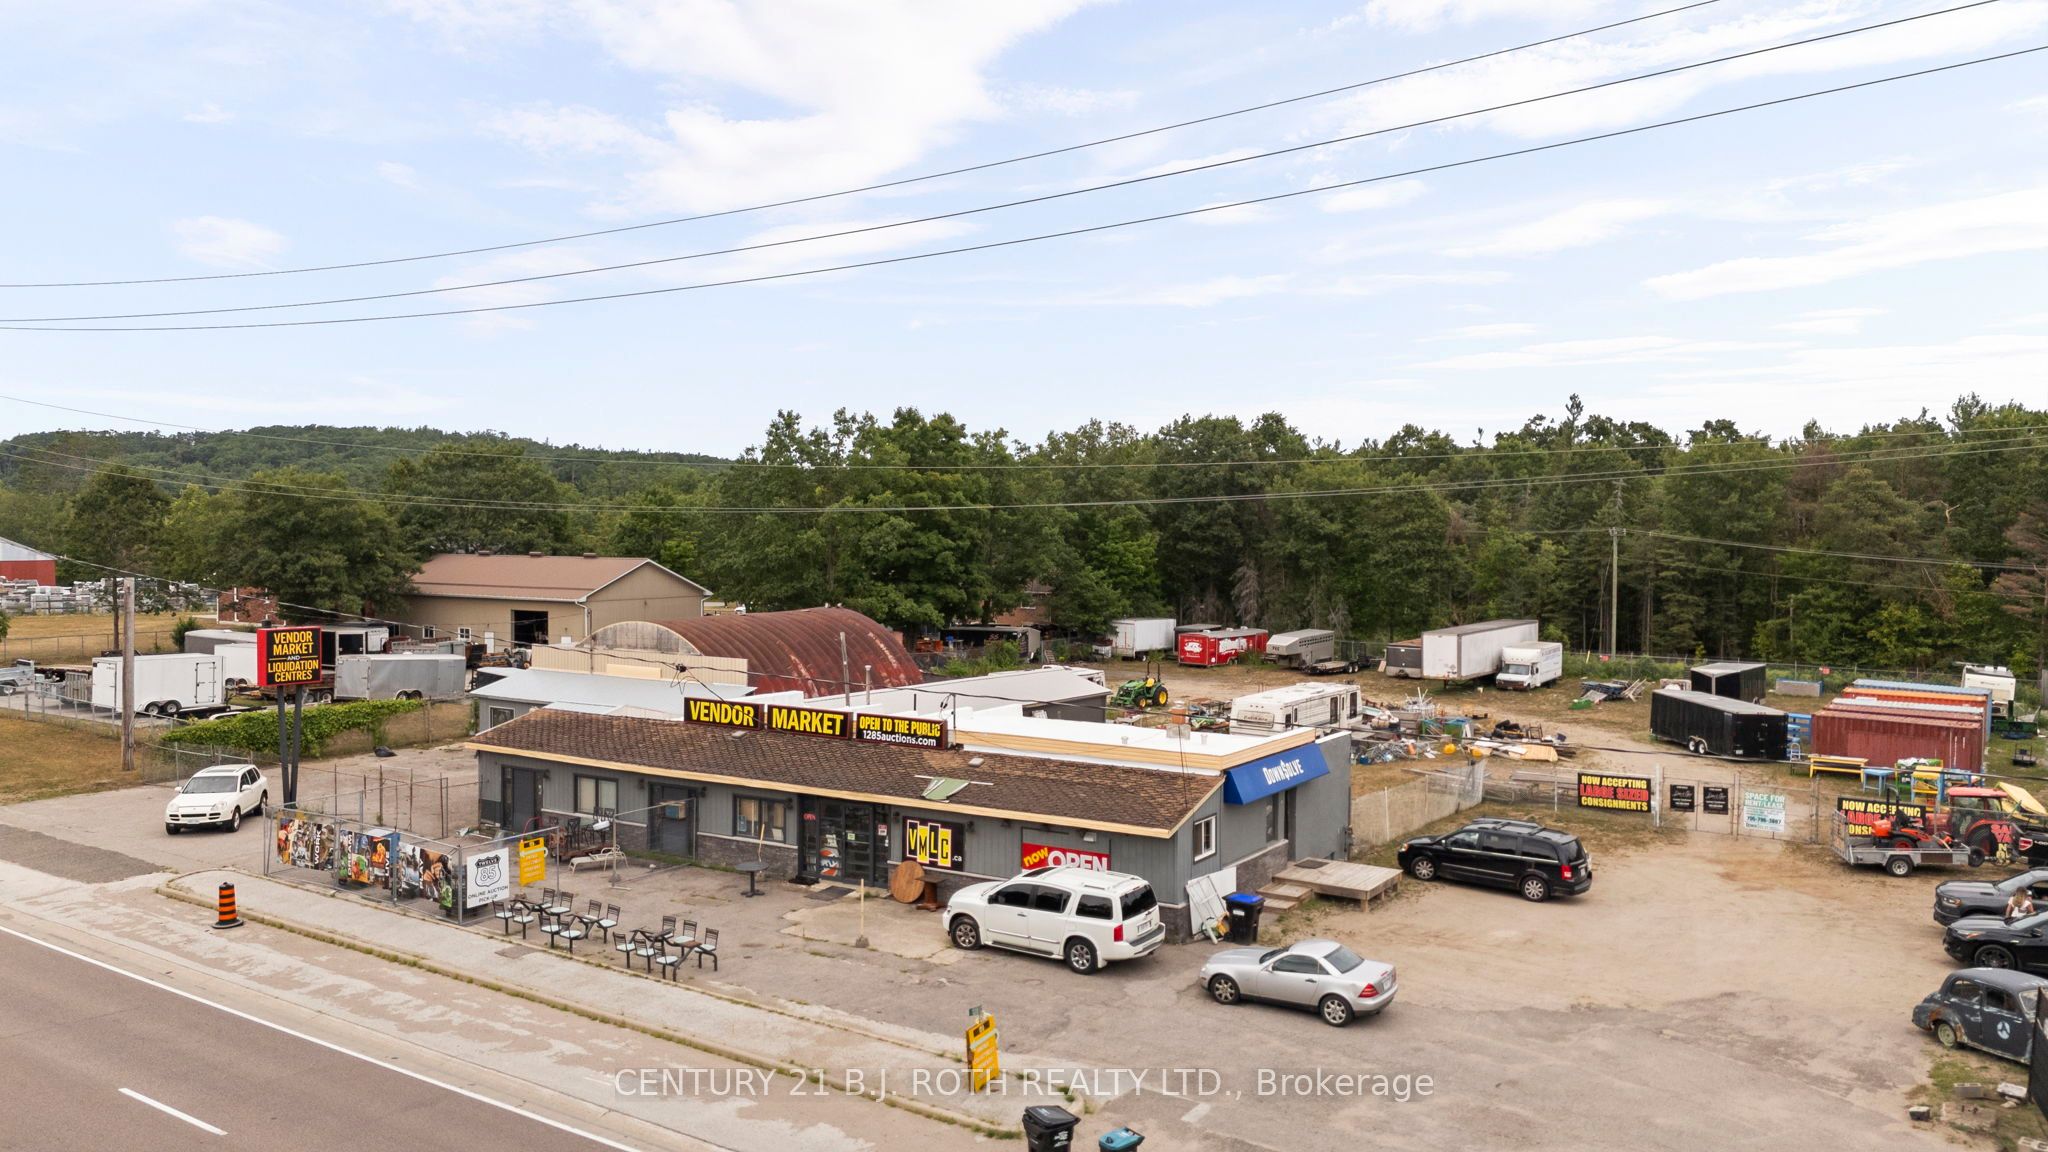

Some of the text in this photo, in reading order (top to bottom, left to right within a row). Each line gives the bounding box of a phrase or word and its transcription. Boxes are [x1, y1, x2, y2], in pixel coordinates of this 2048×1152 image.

[273, 631, 313, 644] VENDOR
[273, 642, 314, 656] MARKET
[268, 659, 319, 673] LIQUIDATION
[274, 670, 313, 683] CENTRES
[690, 700, 844, 736] VENDOR MARKET
[859, 716, 941, 737] OPEN TO THE PUBLIC
[862, 730, 937, 746] 1285auctions.com
[1581, 775, 1647, 790] NOW ACCEPTING
[1580, 784, 1649, 801] LARGE SIZED
[1744, 791, 1769, 801] SPACE
[1581, 796, 1648, 811] CONSIGNMENTS
[1842, 800, 1866, 812] NOW
[314, 830, 322, 865] WORK
[478, 857, 498, 867] TWELVE
[1023, 847, 1049, 867] now
[480, 865, 497, 881] 85
[468, 885, 509, 899] ONLINE AUCTION
